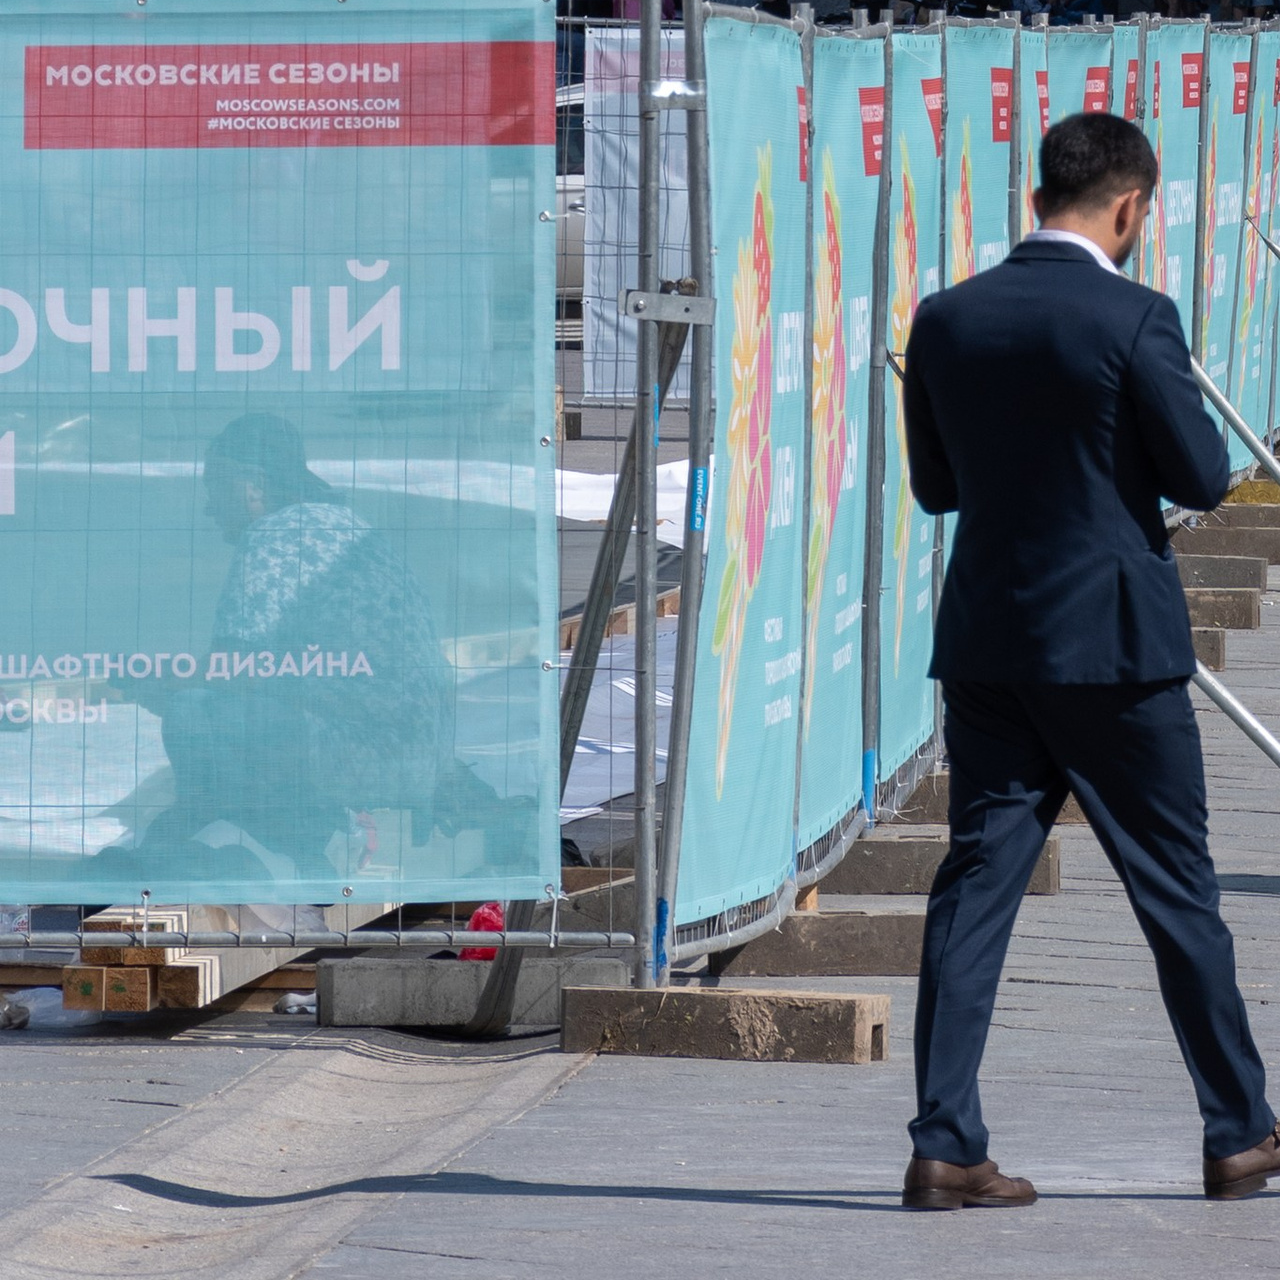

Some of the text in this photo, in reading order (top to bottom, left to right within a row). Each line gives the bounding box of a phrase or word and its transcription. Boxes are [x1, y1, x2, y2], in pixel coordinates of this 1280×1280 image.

[46, 62, 400, 87] МОСКОВСКИЕ СЕЗОНЫ
[216, 98, 400, 113] MOSCOWSEASONS.COM
[207, 116, 400, 130] #МОСКОВСКИЕ СЕЗОНЫ
[205, 644, 375, 681] ДИЗАЙНА
[0, 698, 109, 724] СКВЫ
